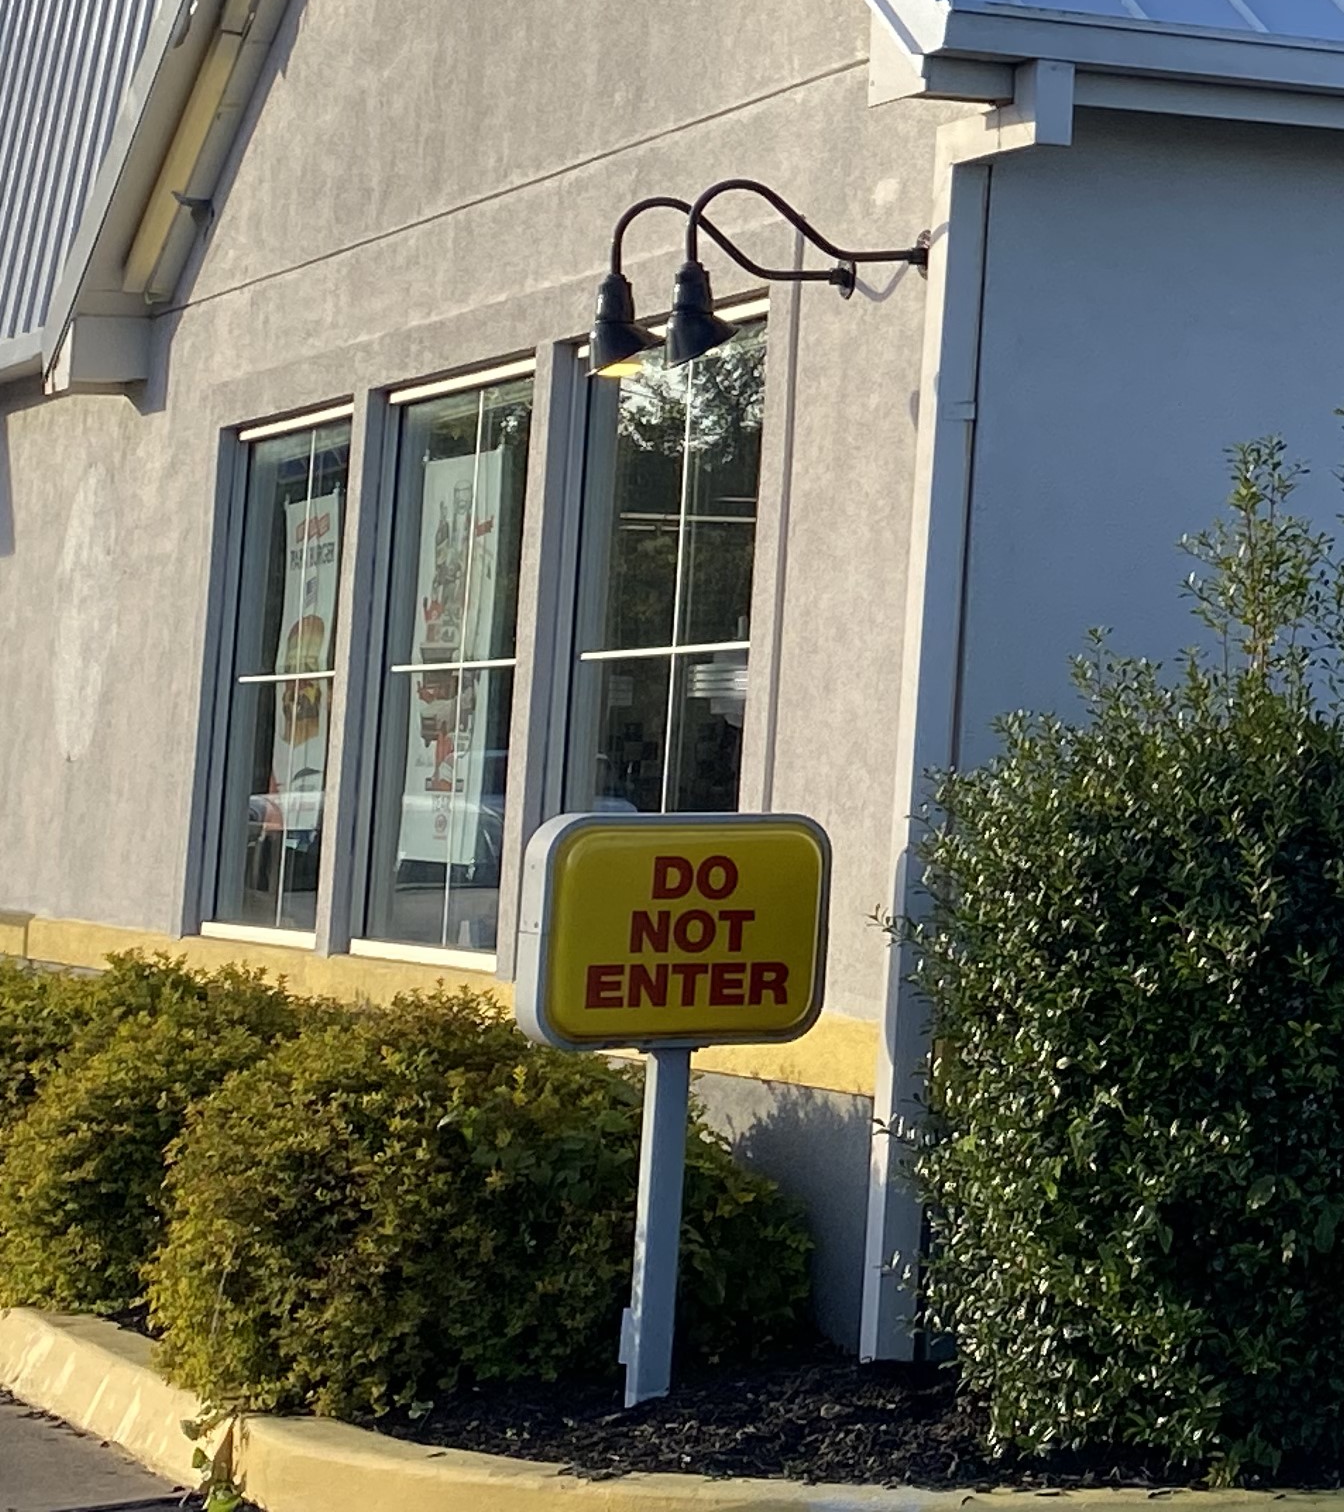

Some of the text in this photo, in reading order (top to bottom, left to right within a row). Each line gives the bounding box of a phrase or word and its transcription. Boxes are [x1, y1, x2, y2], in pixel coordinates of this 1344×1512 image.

[651, 854, 739, 901] DO
[629, 909, 756, 954] NOT
[584, 961, 790, 1010] ENTER
